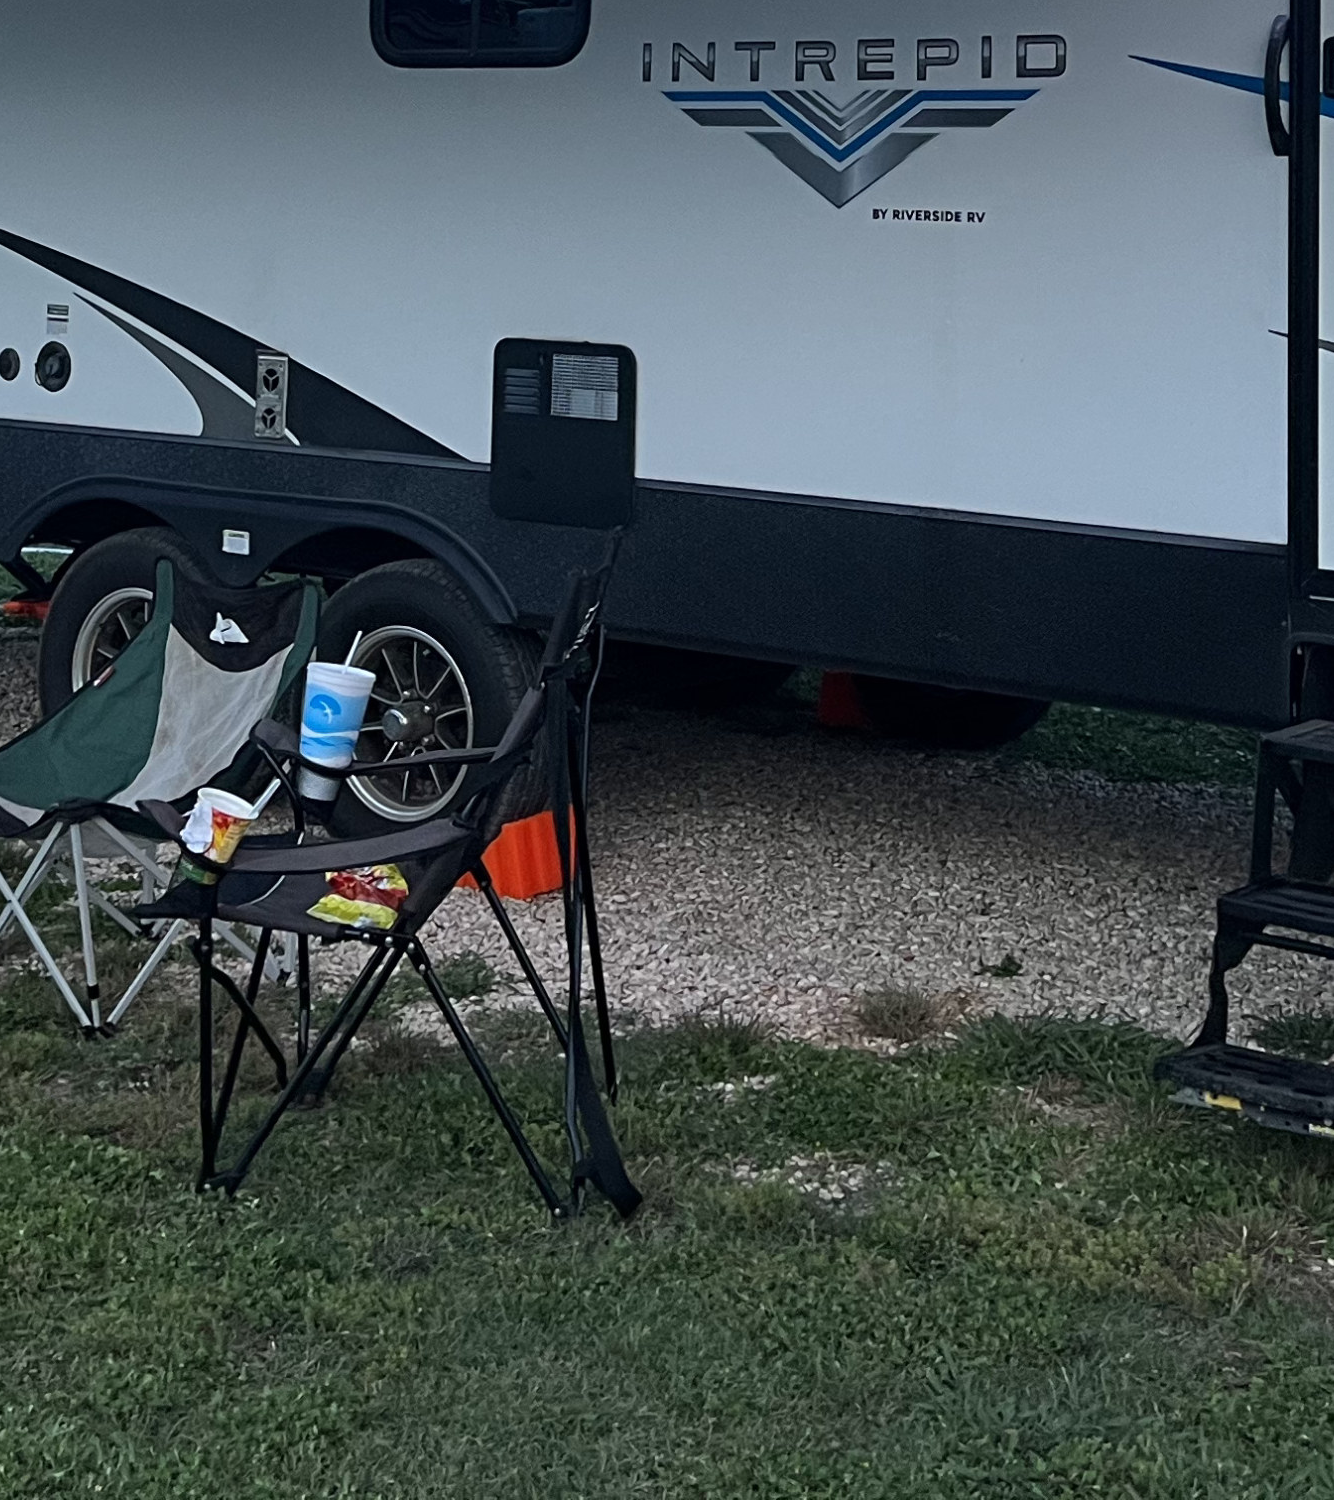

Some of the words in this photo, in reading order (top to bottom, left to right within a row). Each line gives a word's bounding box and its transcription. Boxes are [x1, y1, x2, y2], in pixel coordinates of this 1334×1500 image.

[641, 34, 1067, 82] INTREPID
[872, 208, 888, 220] BY
[892, 209, 962, 222] RIVERSIDE
[967, 211, 986, 223] RV
